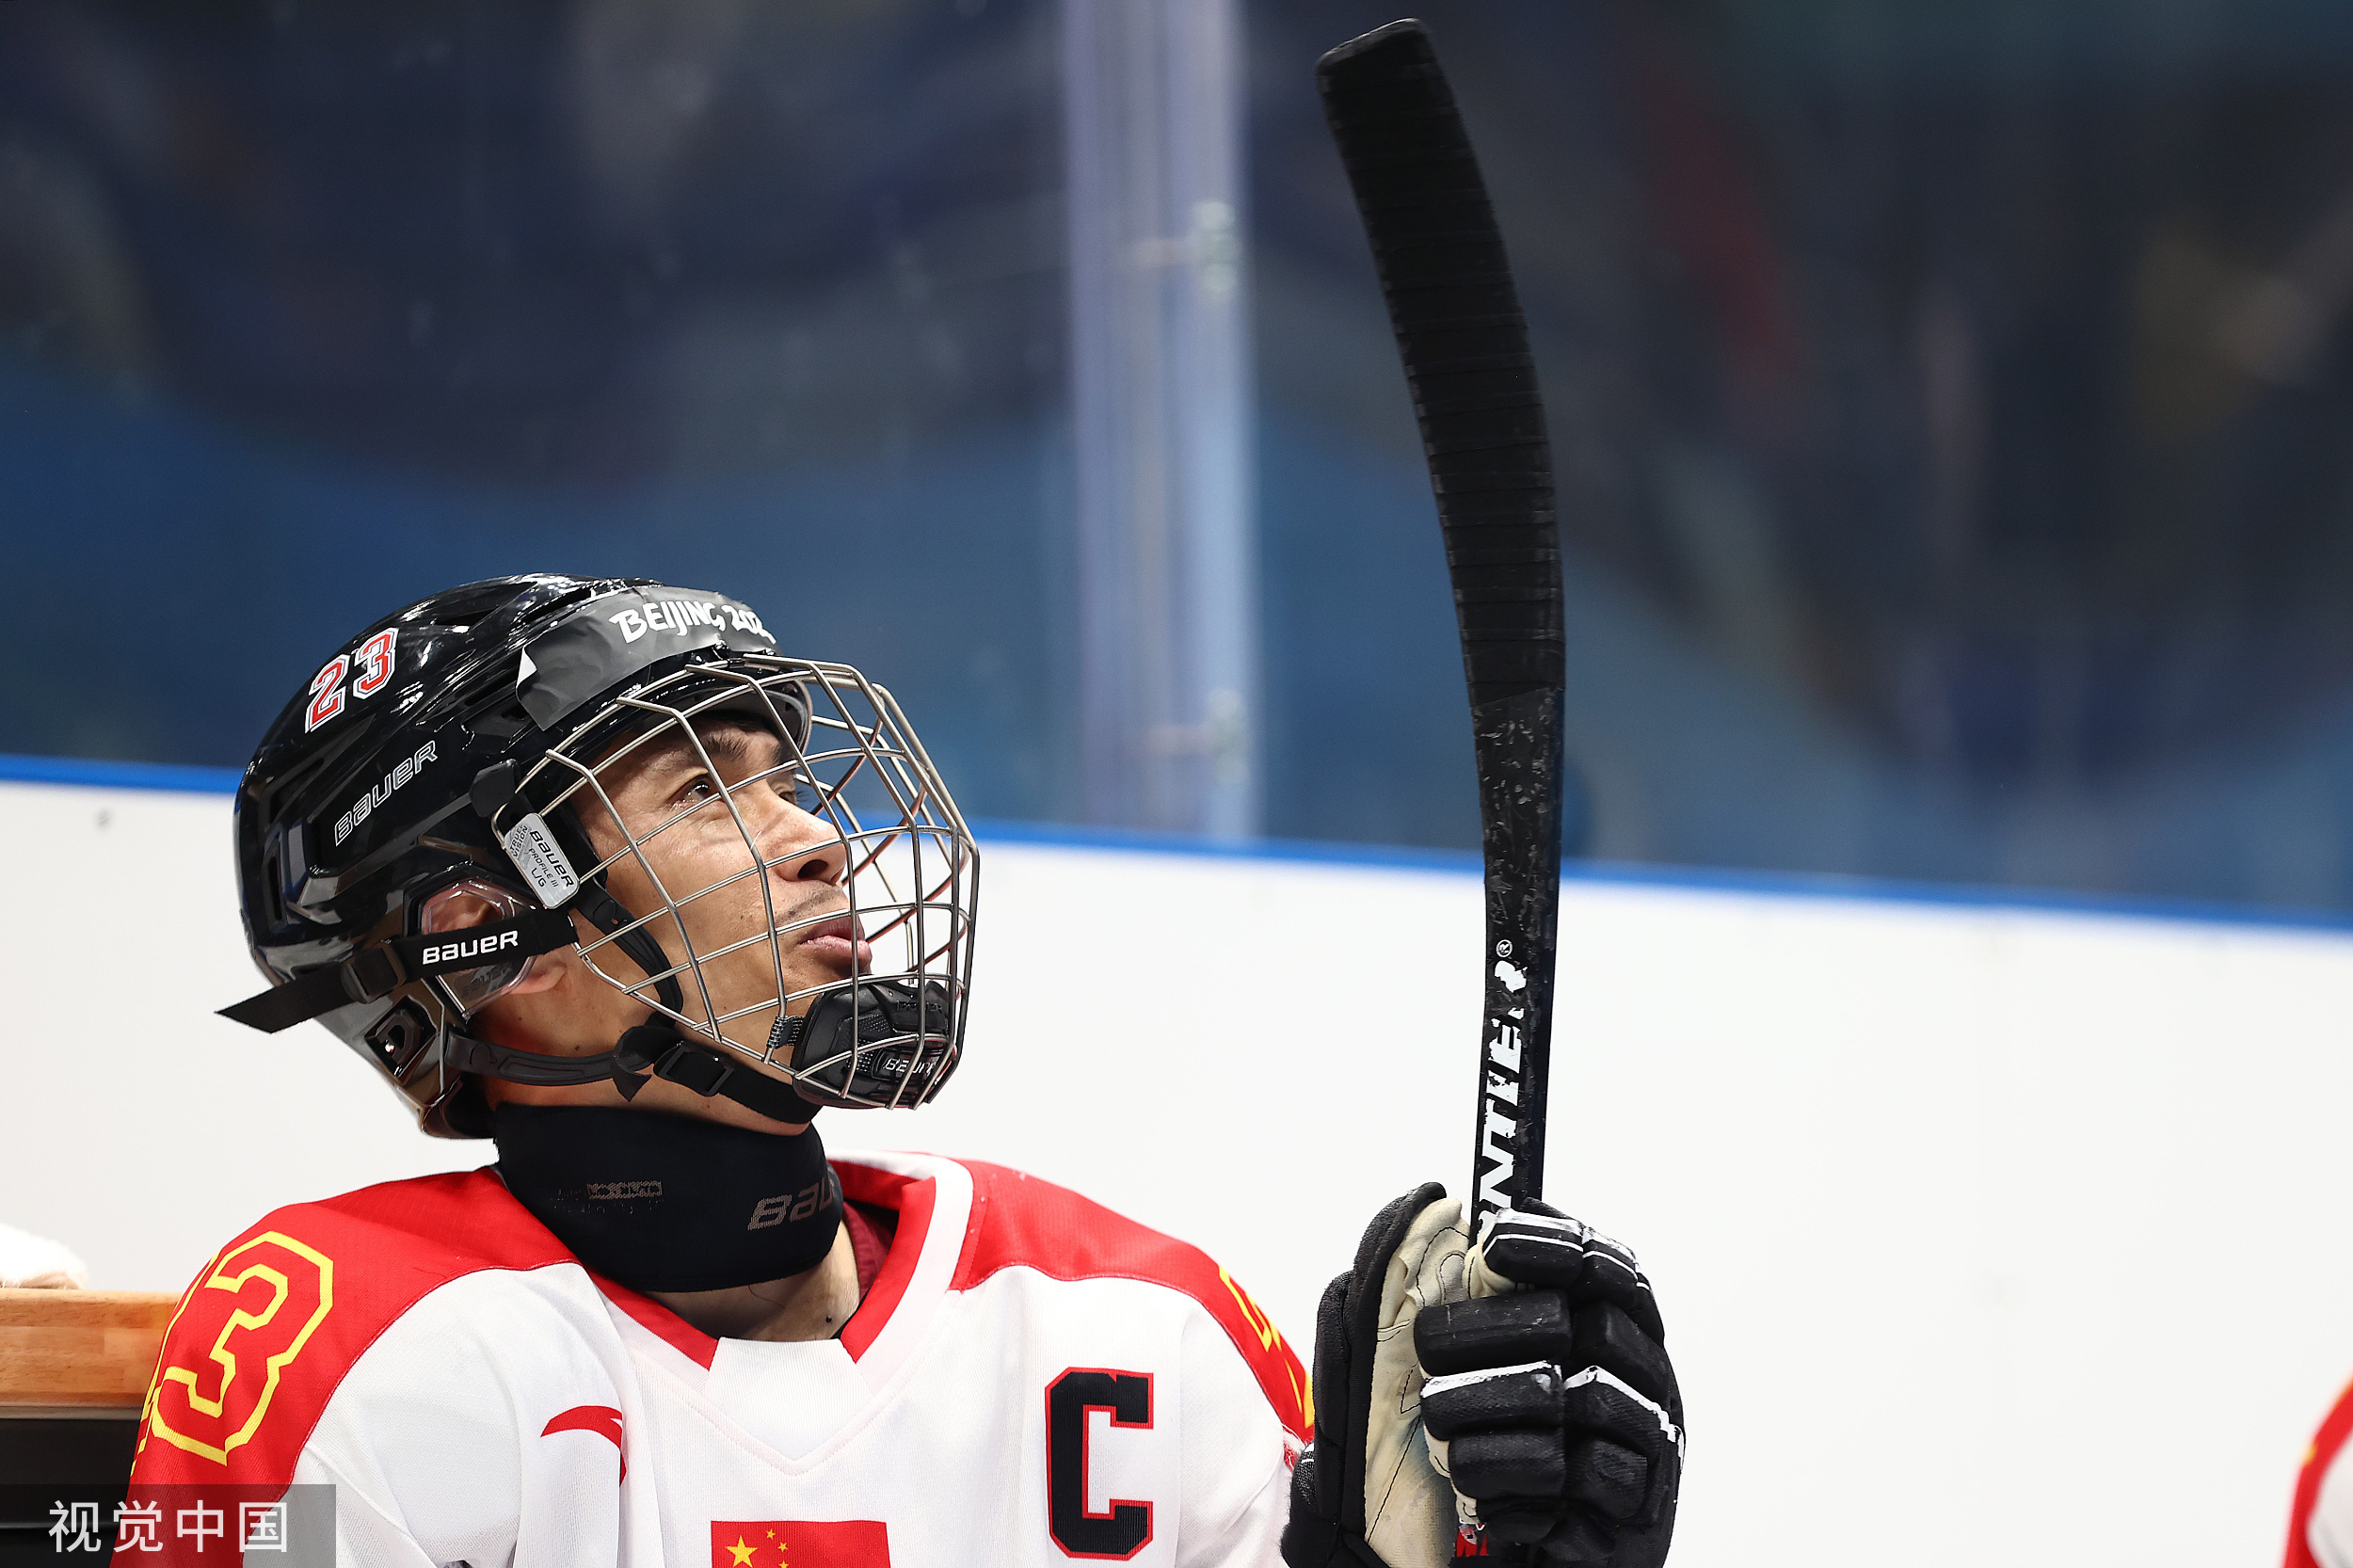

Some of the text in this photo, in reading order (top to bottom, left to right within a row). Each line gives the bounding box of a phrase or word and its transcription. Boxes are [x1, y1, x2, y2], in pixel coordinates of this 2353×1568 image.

[608, 600, 777, 645] BEIJING 202
[305, 627, 399, 734] 23
[529, 848, 553, 878] PROFILE
[131, 1230, 334, 1476] 3
[1045, 1367, 1154, 1561] C
